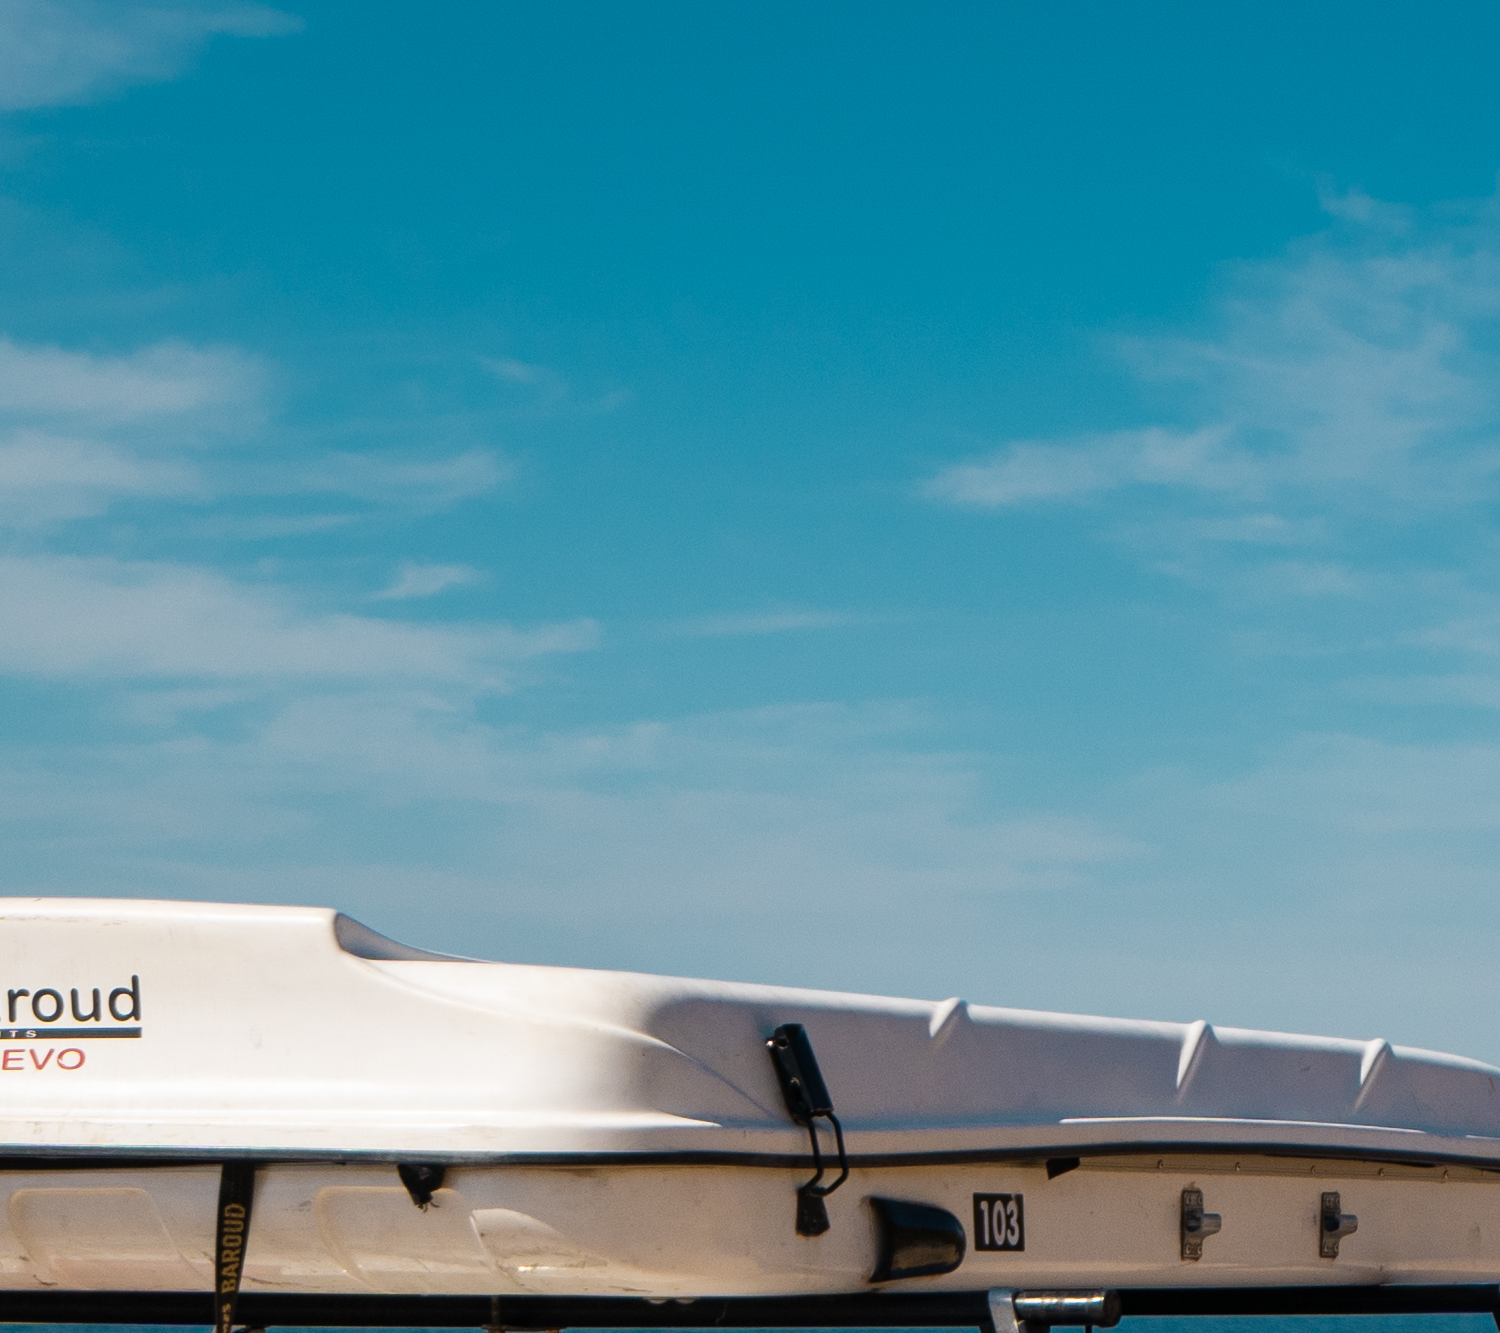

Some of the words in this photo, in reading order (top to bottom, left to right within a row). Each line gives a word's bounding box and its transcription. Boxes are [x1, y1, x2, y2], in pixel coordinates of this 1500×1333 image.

[1, 1047, 87, 1071] EVO
[980, 1200, 1020, 1246] 103
[222, 1203, 246, 1294] BAROUD
